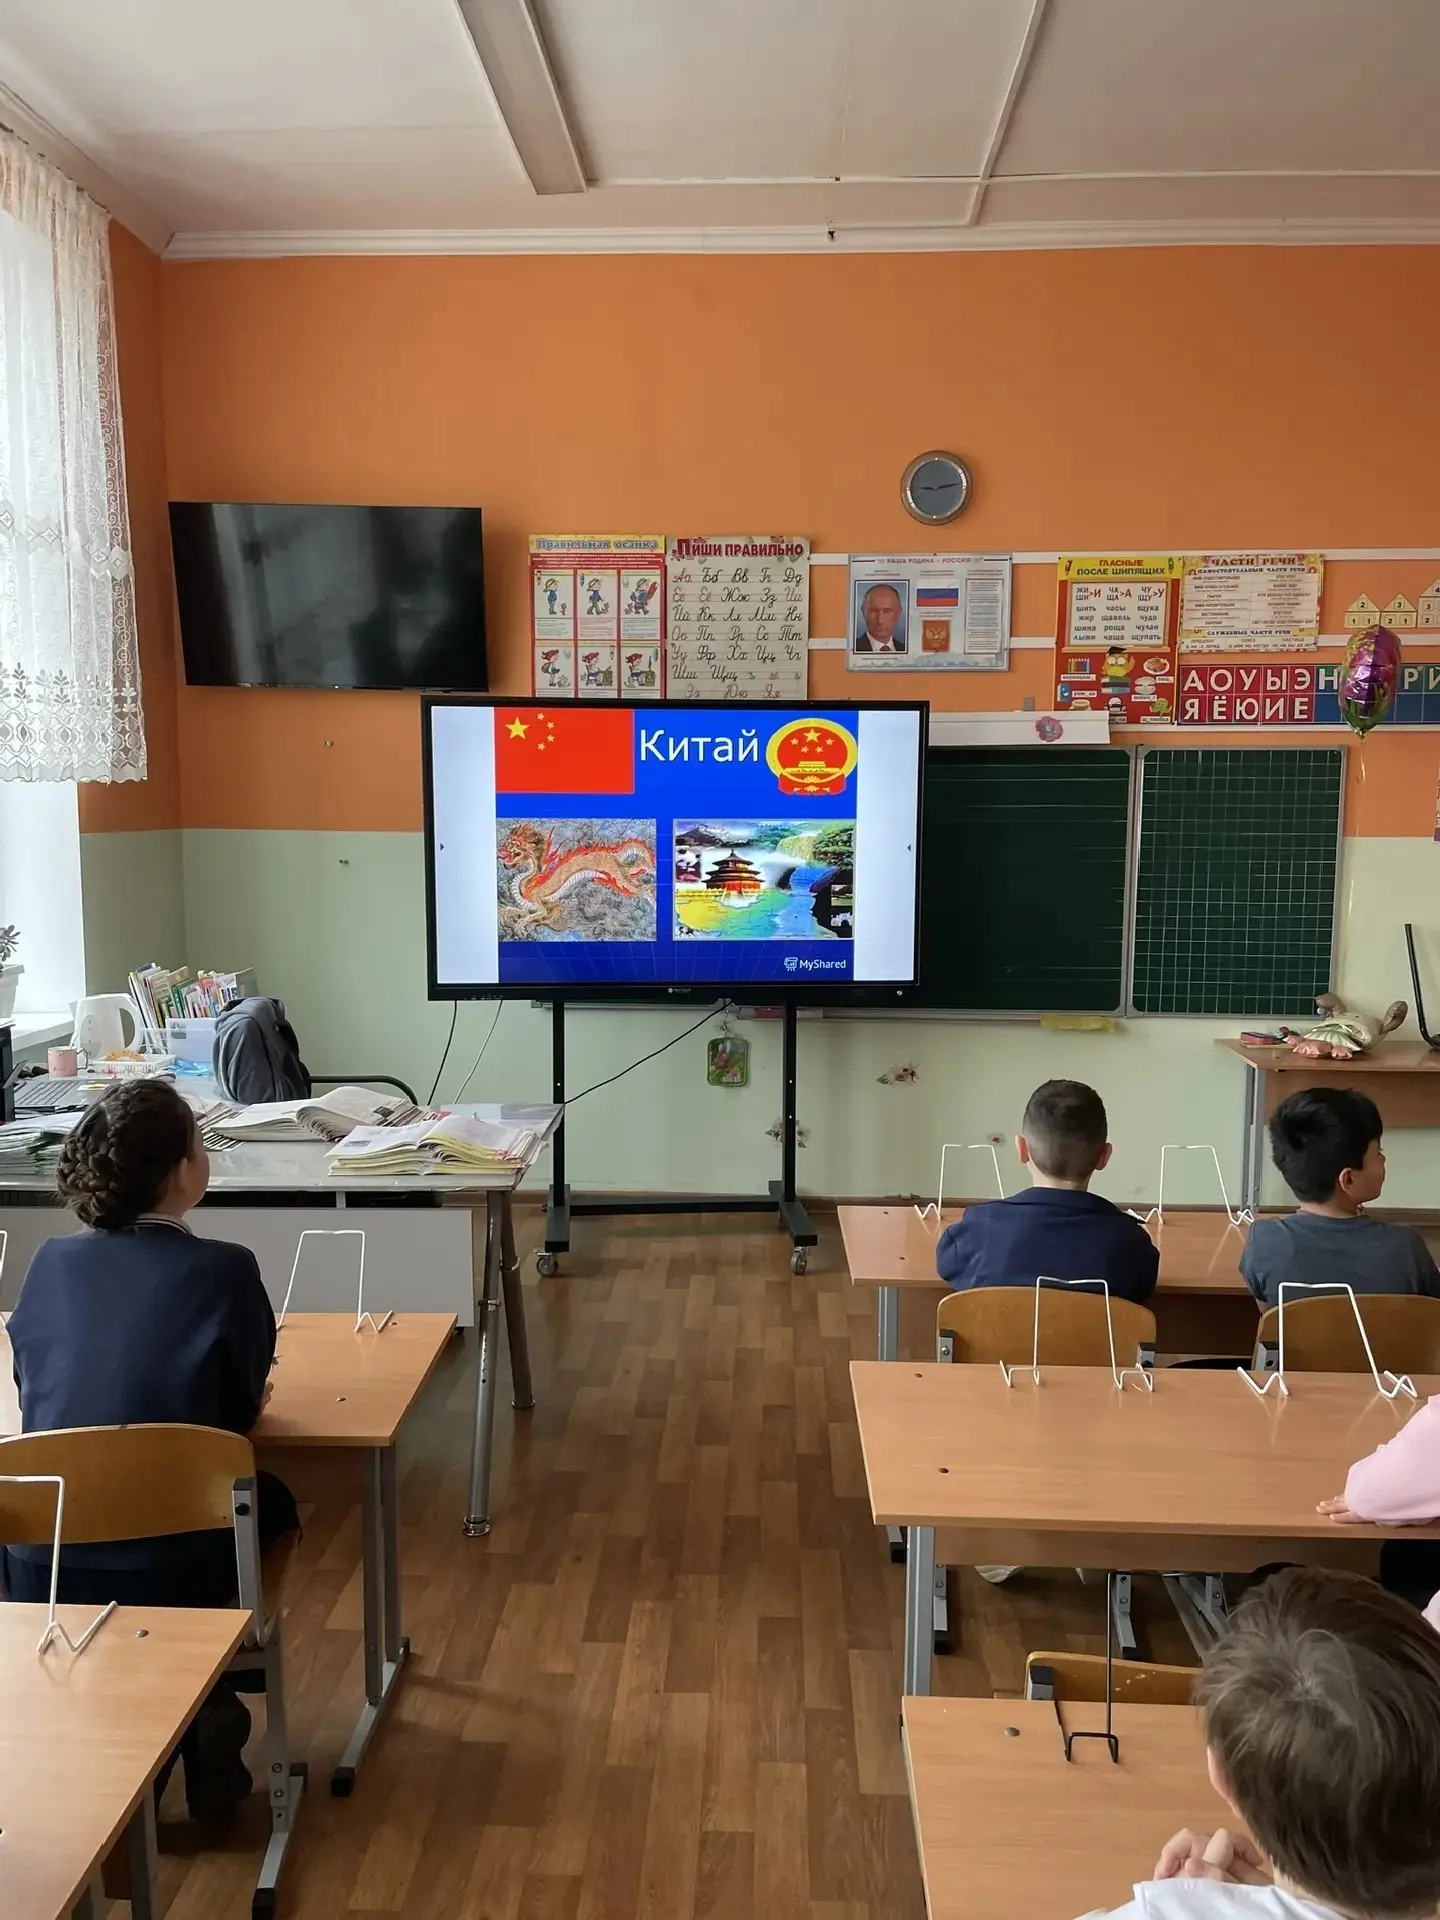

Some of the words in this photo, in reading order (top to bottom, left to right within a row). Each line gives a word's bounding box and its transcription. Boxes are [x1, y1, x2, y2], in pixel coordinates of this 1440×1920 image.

[537, 538, 612, 551] Правильная
[614, 540, 658, 550] осанка
[725, 543, 804, 557] ПРАВИЛЬНО
[886, 557, 907, 565] НАША
[908, 557, 935, 565] РОДИНА
[1211, 558, 1255, 567] ЧАСТИ
[1262, 557, 1296, 566] РЕЧИ
[1076, 568, 1109, 576] ПОСЛЕ
[1111, 568, 1165, 577] ШИПЯЩИХ
[1141, 586, 1152, 594] ЧУ
[1106, 594, 1119, 602] ЩА
[1138, 594, 1152, 602] ЩУ
[1076, 605, 1097, 613] шить
[1105, 605, 1126, 613] часы
[1360, 601, 1366, 609] 2
[1396, 601, 1402, 609] 3
[1137, 605, 1159, 614] щука
[1078, 615, 1094, 623] жир
[1101, 614, 1131, 622] щавель
[1139, 614, 1158, 622] чудо
[1103, 625, 1125, 634] роща
[1135, 624, 1159, 632] чулан
[1131, 634, 1161, 643] щупать
[640, 728, 759, 763] Китай
[799, 959, 847, 971] MyShared
